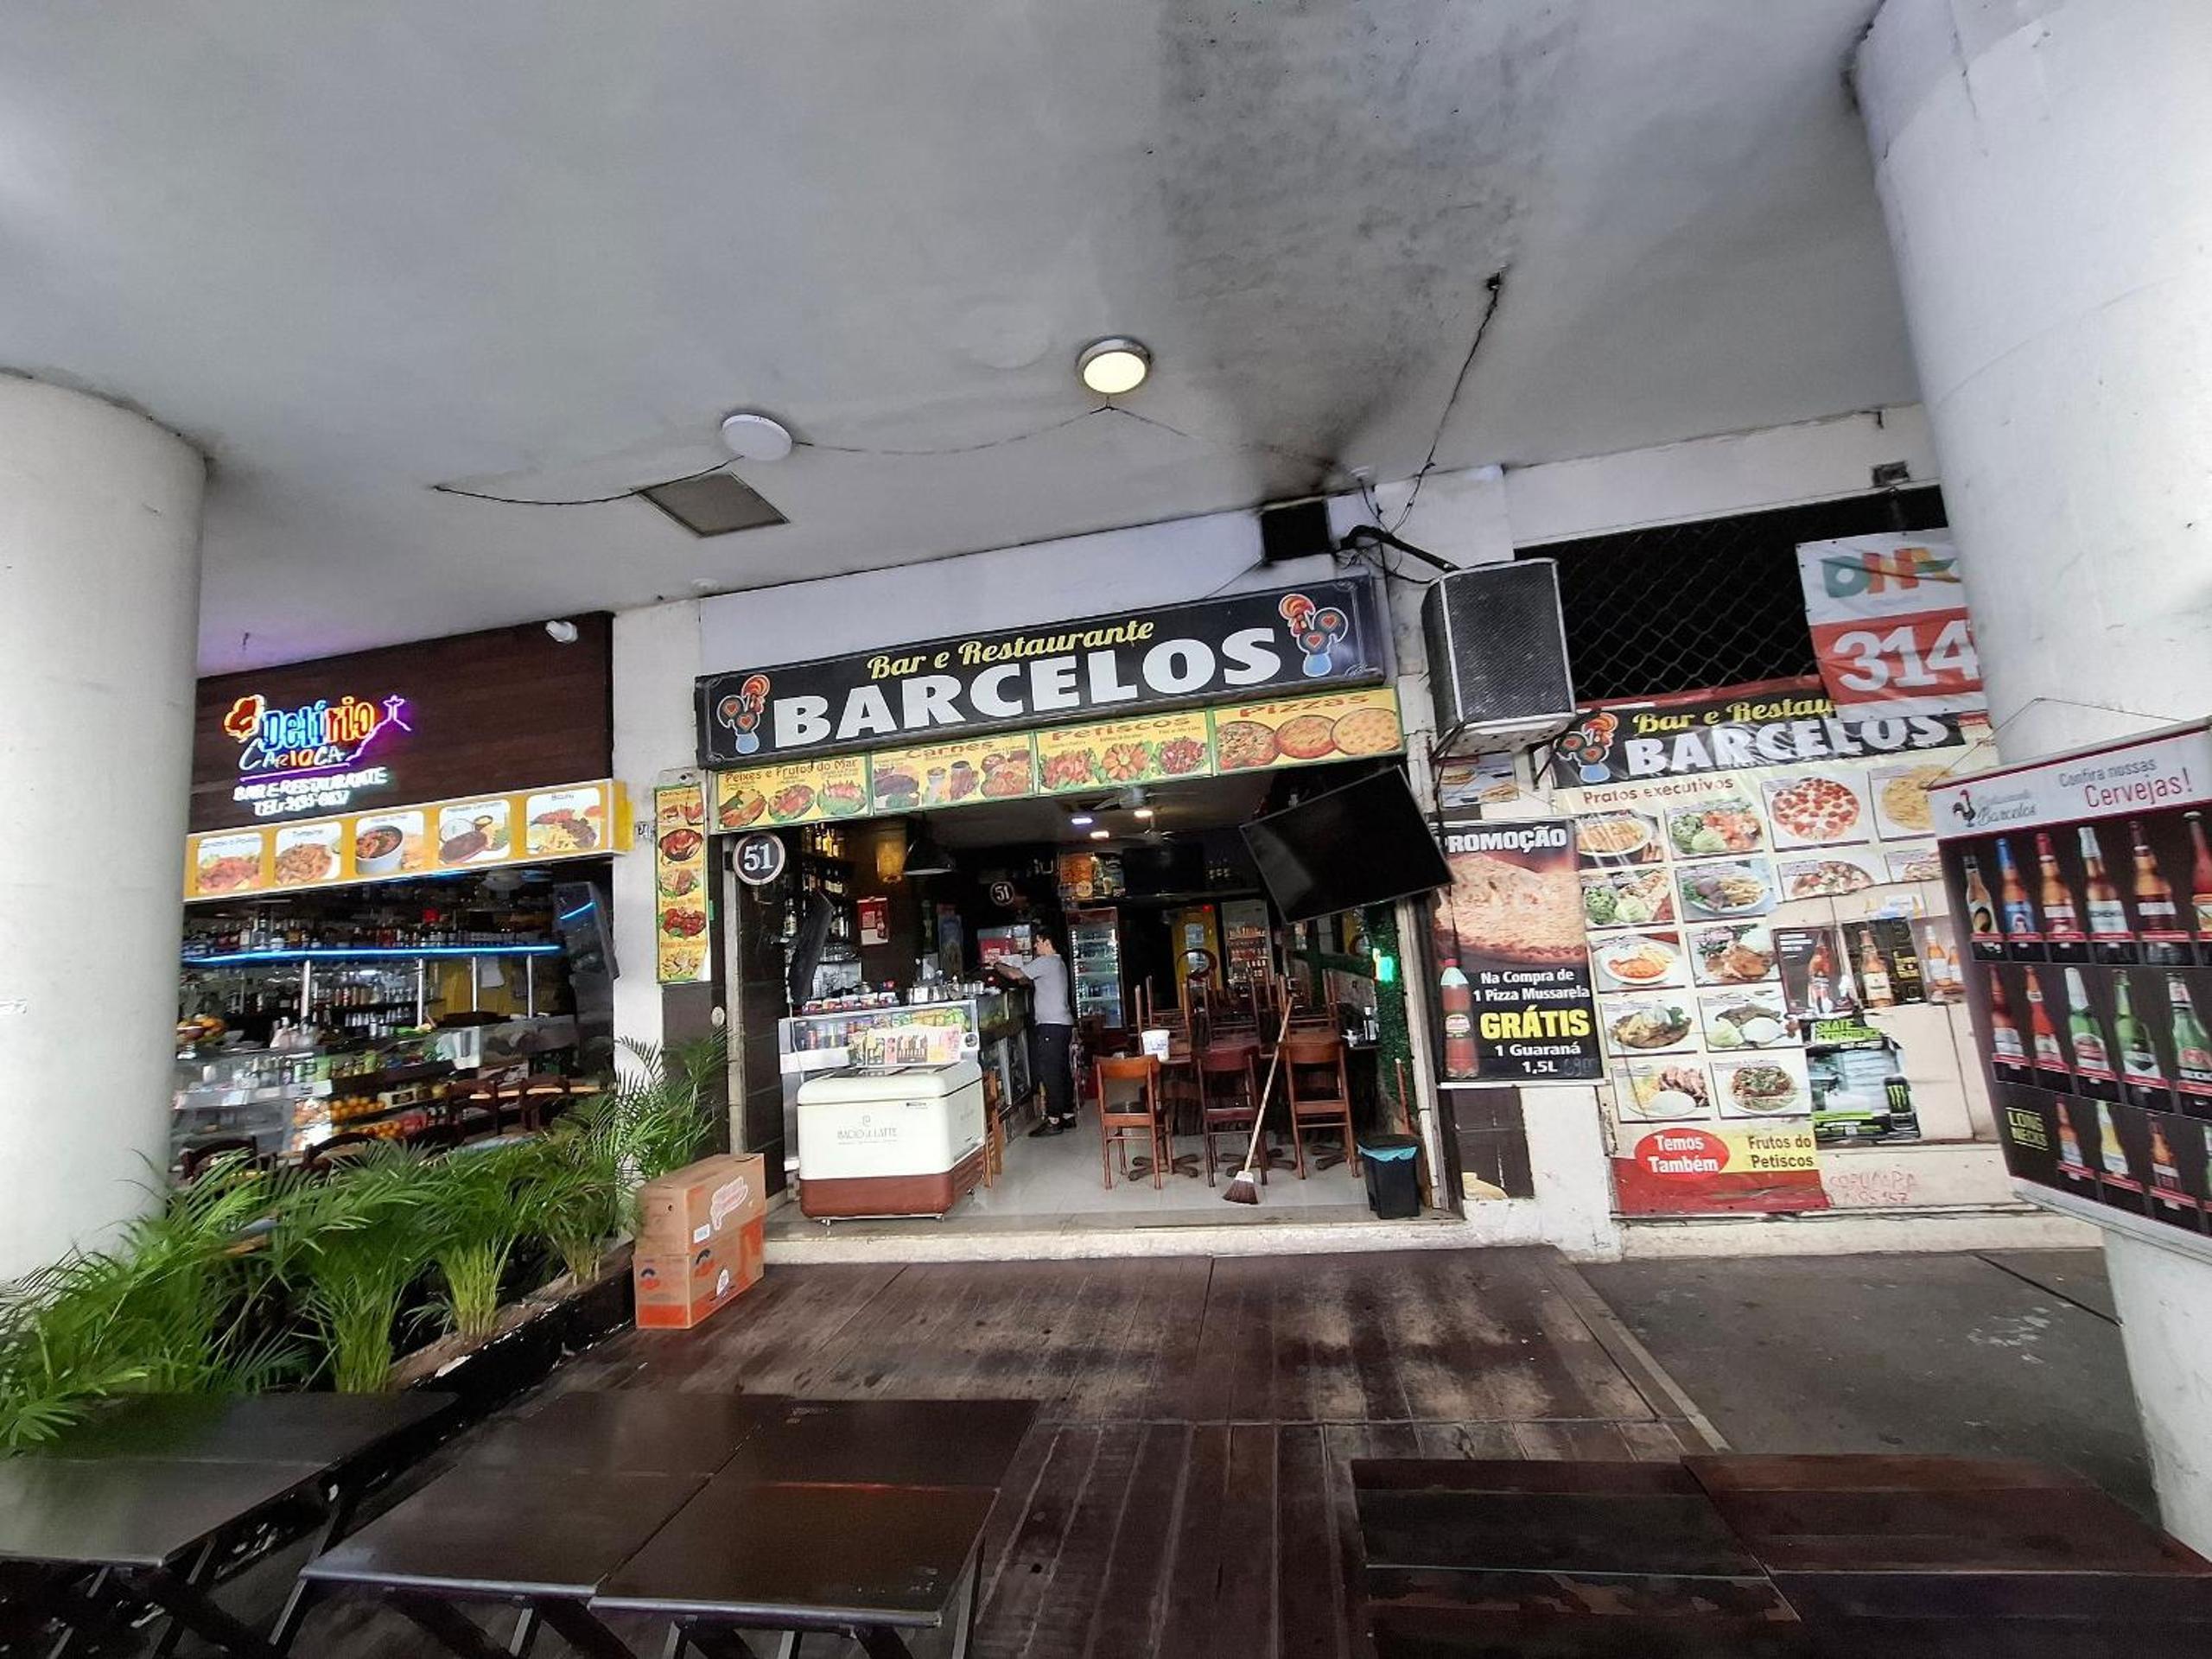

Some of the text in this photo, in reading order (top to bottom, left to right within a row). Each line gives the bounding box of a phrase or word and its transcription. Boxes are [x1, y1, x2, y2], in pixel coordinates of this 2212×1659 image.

[867, 620, 1154, 679] Bar e Restaurante
[1834, 620, 1980, 691] 314
[774, 628, 1283, 749] BARCELOS
[1239, 696, 1370, 717] Pizzas
[1052, 717, 1191, 741] Petiscos
[1632, 713, 1695, 734] Bar
[1704, 711, 1719, 725] e
[906, 741, 995, 759] Carnes
[1624, 715, 1948, 776] BARCELOS
[725, 771, 761, 783] Peixes
[817, 761, 831, 772] do
[2108, 759, 2158, 778] nossas
[1583, 778, 1734, 804] Pratos executivos
[2085, 766, 2193, 808] Cervejas!
[744, 842, 773, 872] 51
[995, 885, 1010, 900] 51
[1480, 968, 1574, 986] Na Compra de
[1472, 985, 1590, 1001] 1 Pizza Mussarela
[1480, 1004, 1590, 1039] GRÁTIS
[1495, 1041, 1581, 1057] 1 Guaraná
[1655, 1135, 1705, 1151] Temos
[1748, 1135, 1812, 1150] Frutos do
[1647, 1156, 1719, 1173] Também
[1751, 1154, 1815, 1168] Petiscos
